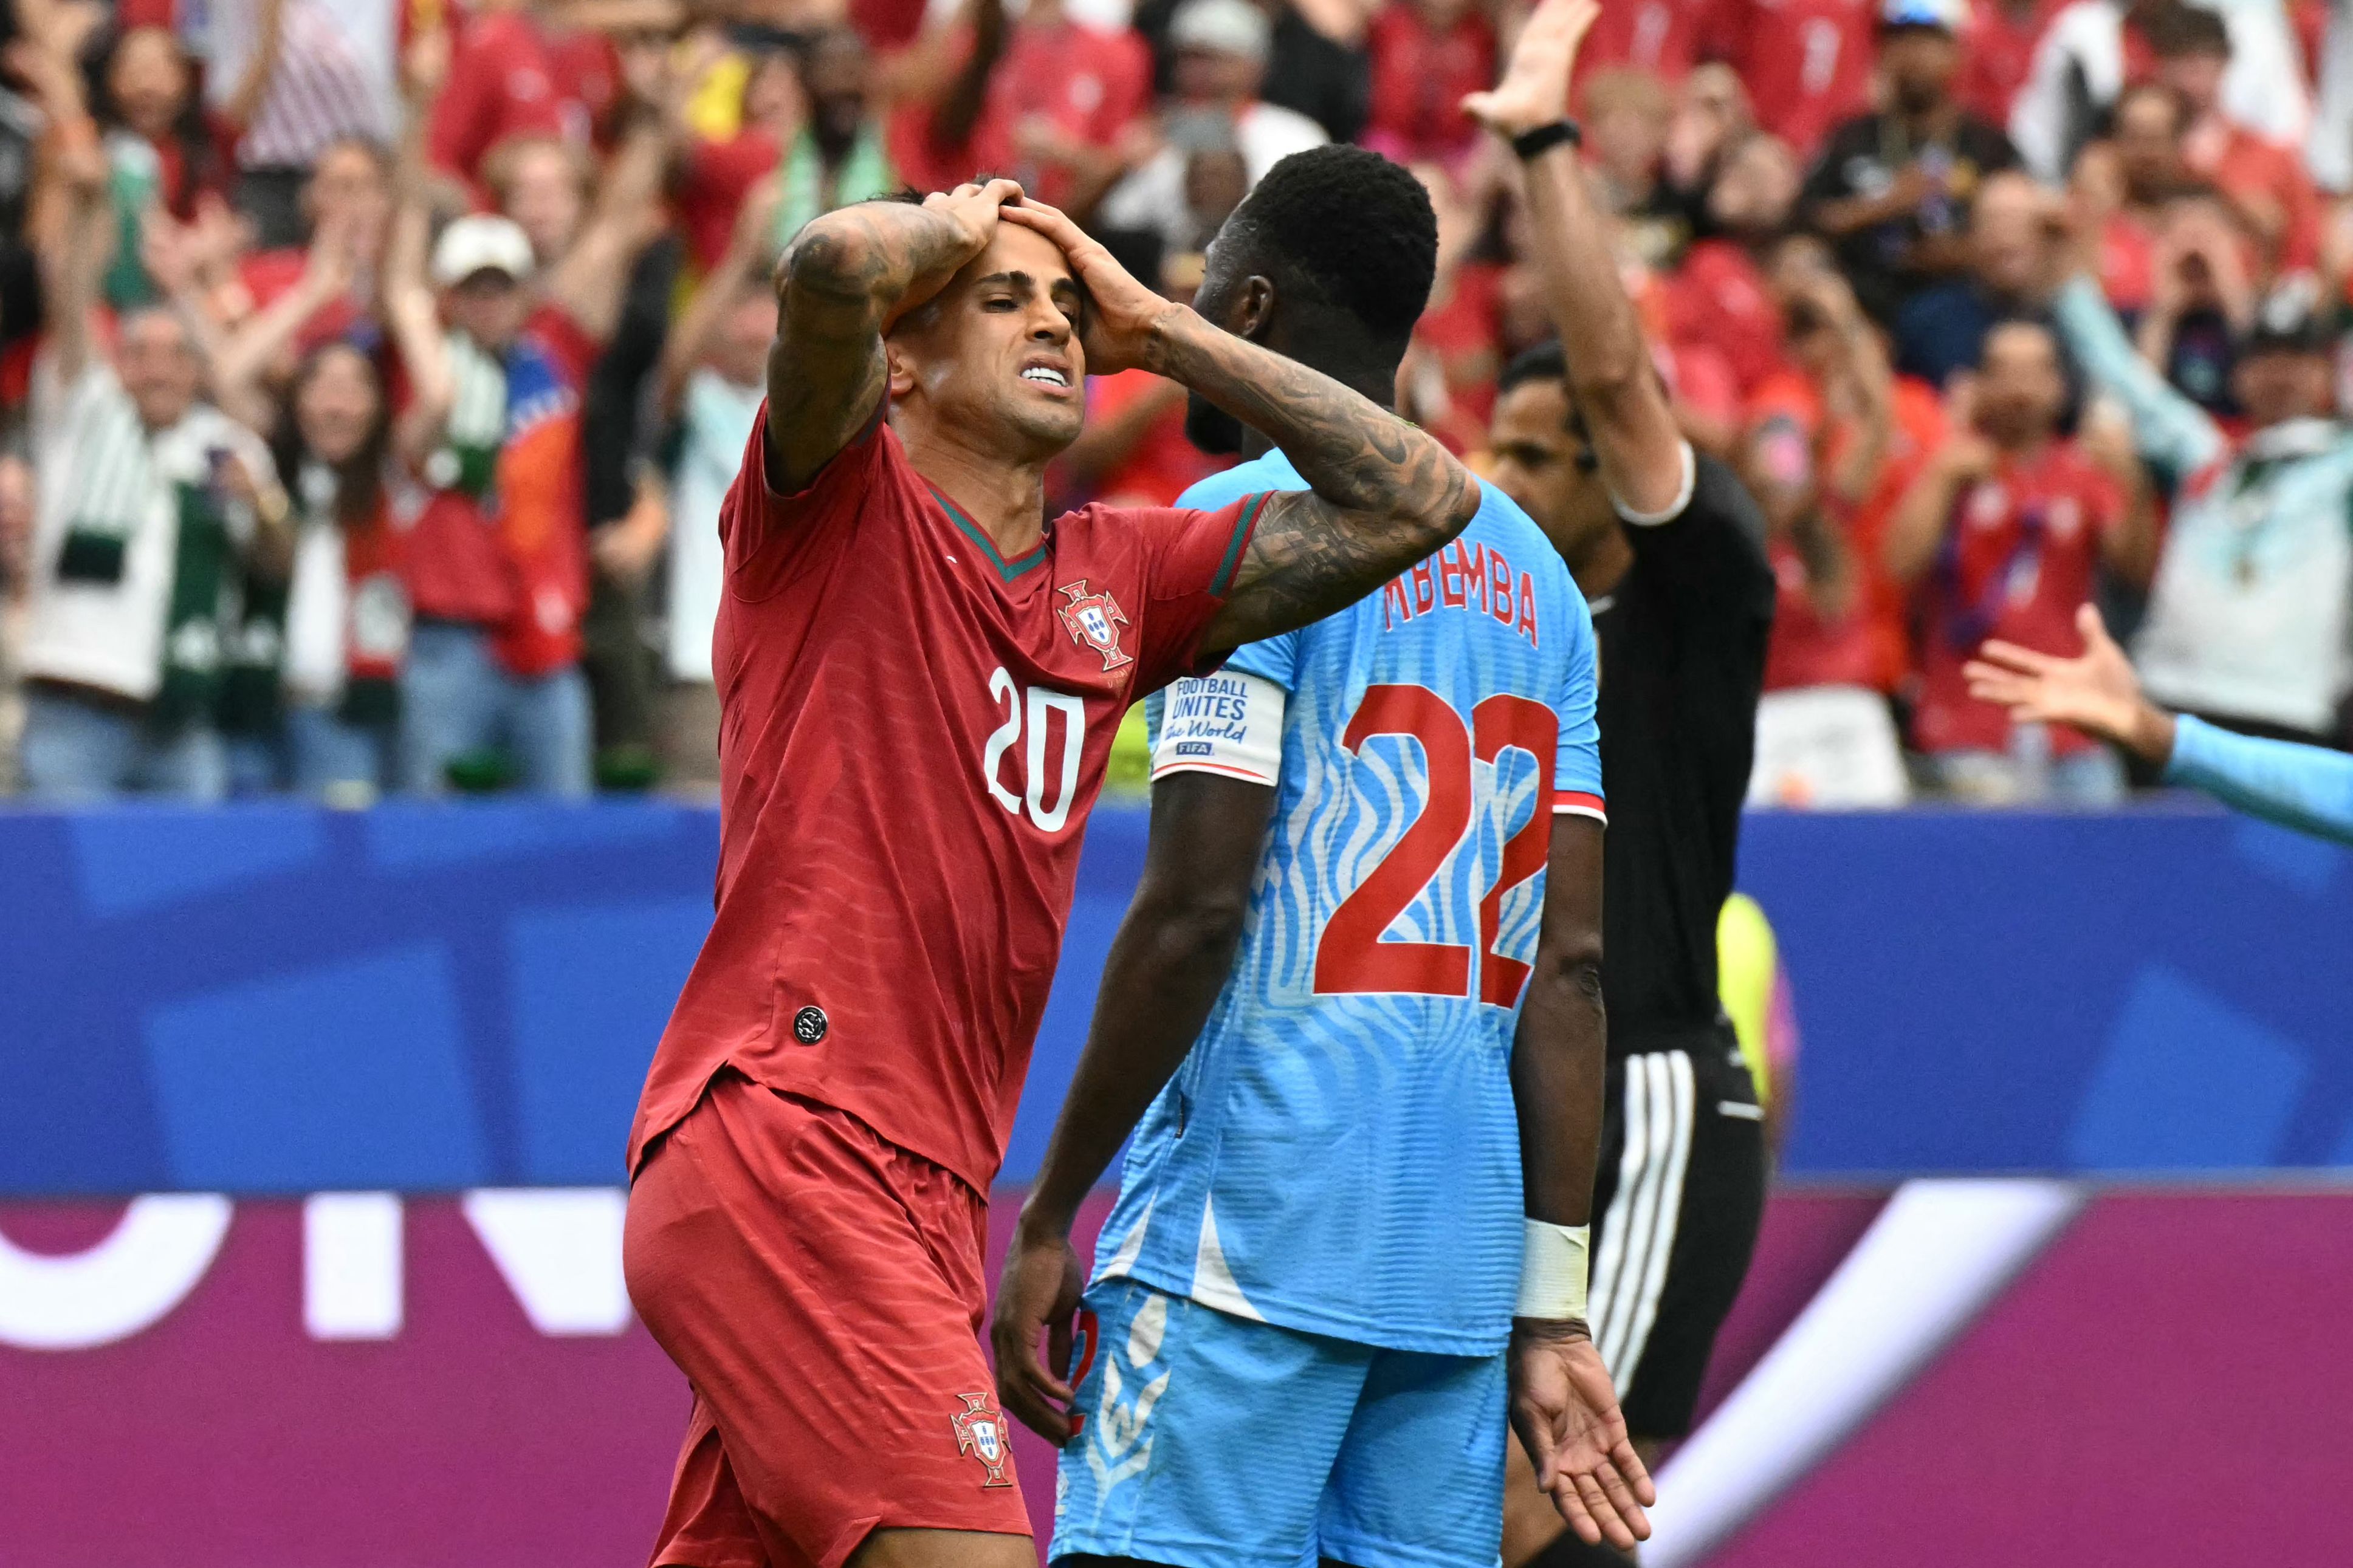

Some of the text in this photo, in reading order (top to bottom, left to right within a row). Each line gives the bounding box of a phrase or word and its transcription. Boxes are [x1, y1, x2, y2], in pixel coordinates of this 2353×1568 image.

[1384, 536, 1539, 650] MBEMBA
[1176, 678, 1248, 698] FOOTBALL
[1172, 695, 1246, 721] UNITES
[1187, 719, 1248, 745] World
[984, 666, 1085, 832] 20
[1178, 743, 1209, 753] FIFA
[1312, 683, 1559, 1010] 22
